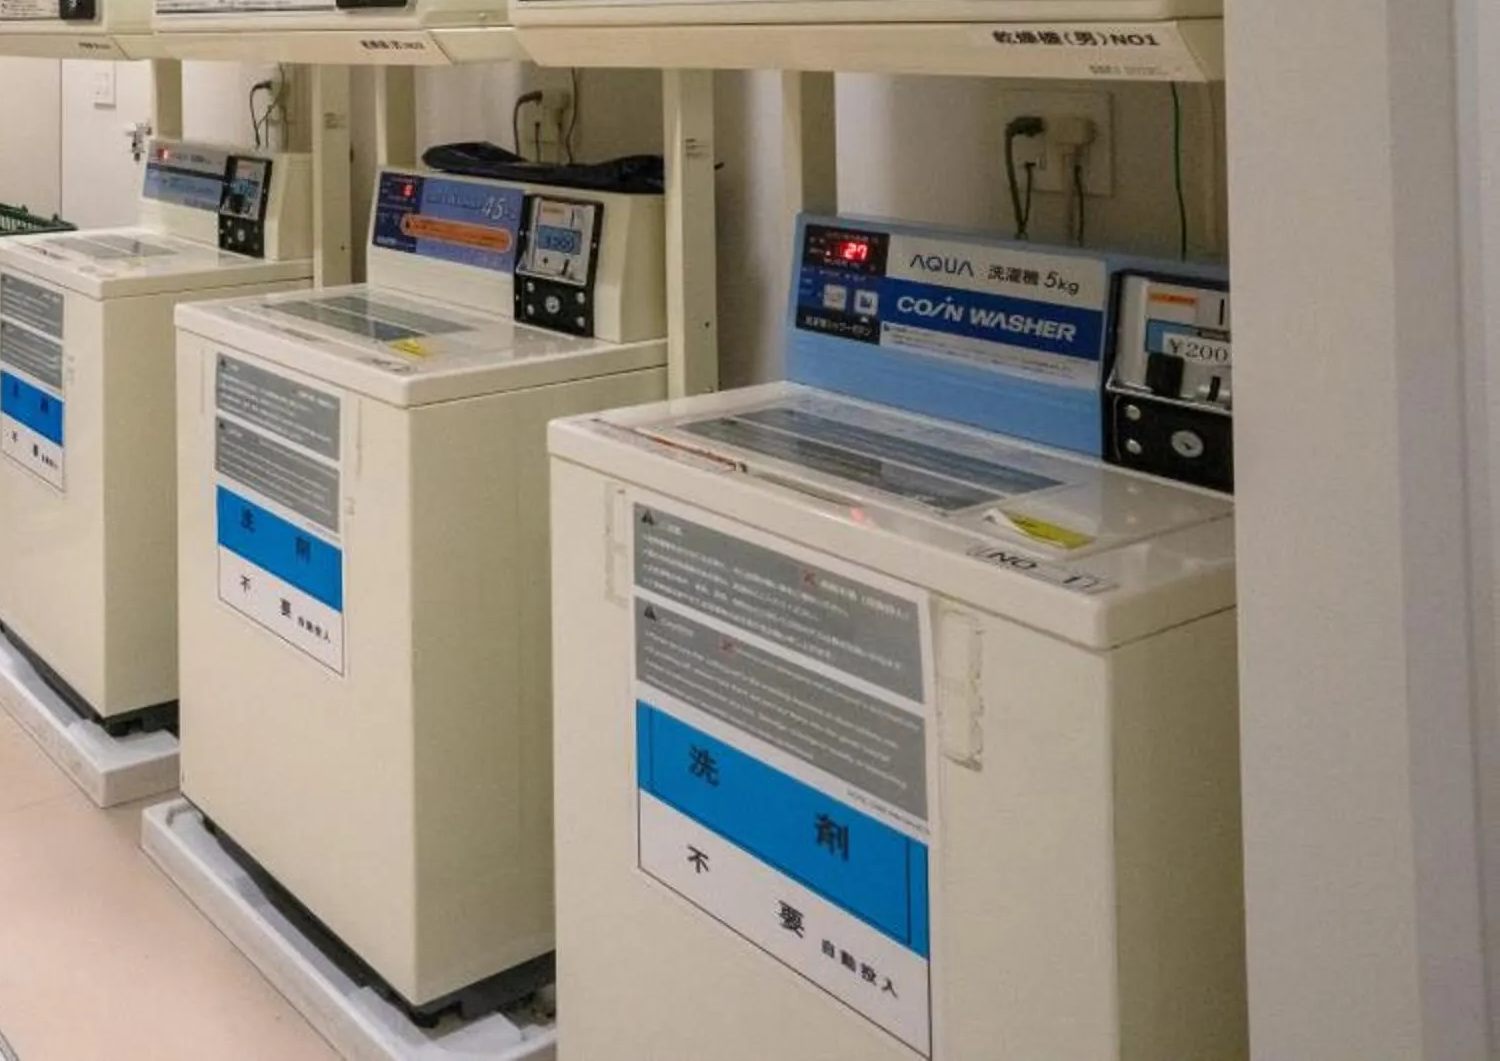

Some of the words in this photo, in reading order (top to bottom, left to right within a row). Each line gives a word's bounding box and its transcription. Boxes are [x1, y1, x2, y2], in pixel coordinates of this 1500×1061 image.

[844, 242, 868, 260] 27
[909, 254, 975, 278] AQUA
[987, 265, 1040, 286] 洗濯機
[1043, 270, 1080, 296] 5kg
[896, 295, 965, 323] COIN
[969, 307, 1077, 343] WASHER
[1168, 339, 1228, 363] ¥200
[820, 939, 899, 999] 自動投入
